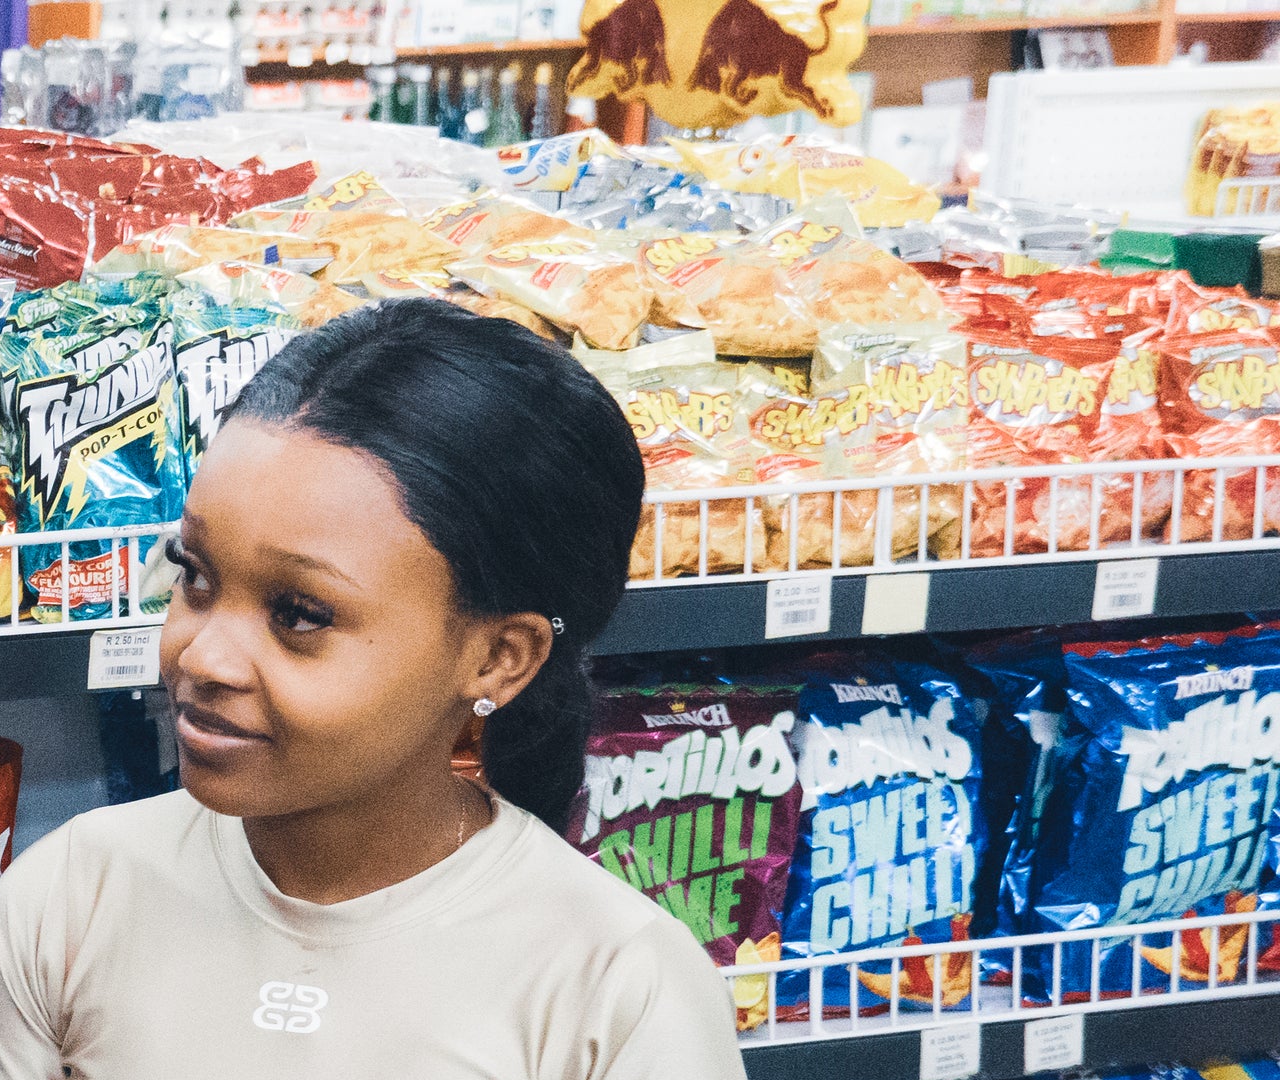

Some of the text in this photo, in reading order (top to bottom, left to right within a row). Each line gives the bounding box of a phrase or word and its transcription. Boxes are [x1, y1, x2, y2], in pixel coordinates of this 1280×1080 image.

[40, 565, 126, 589] FLAOURED
[830, 682, 904, 705] KRUNCH
[1174, 665, 1255, 700] KRUNCH
[641, 703, 732, 728] KRUNCH
[598, 798, 773, 890] CHILLI
